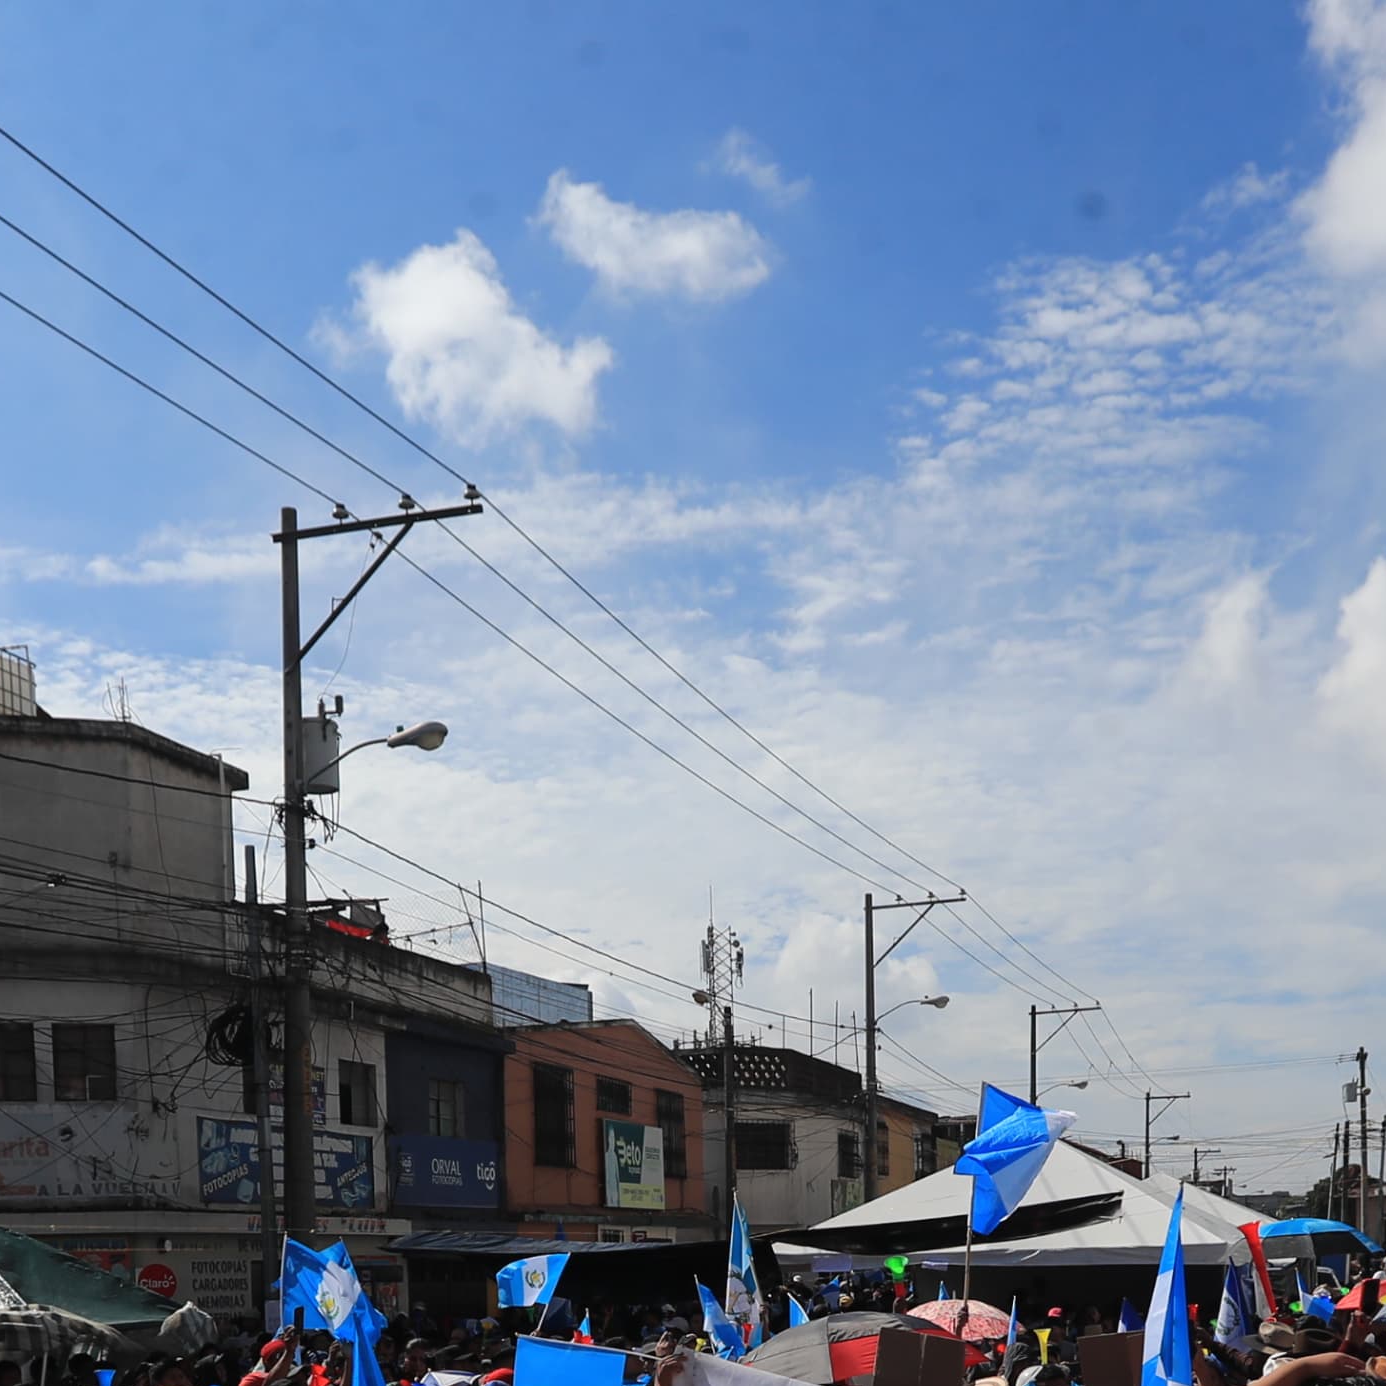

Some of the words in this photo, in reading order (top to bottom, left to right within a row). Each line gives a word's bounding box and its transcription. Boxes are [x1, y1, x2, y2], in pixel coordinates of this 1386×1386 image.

[431, 1157, 462, 1176] ORVAL
[202, 1163, 250, 1197] FOTOCOPIAS
[190, 1260, 248, 1274] FOTOCOPIAS
[139, 1276, 170, 1289] Claro
[191, 1277, 249, 1291] CARGADORES
